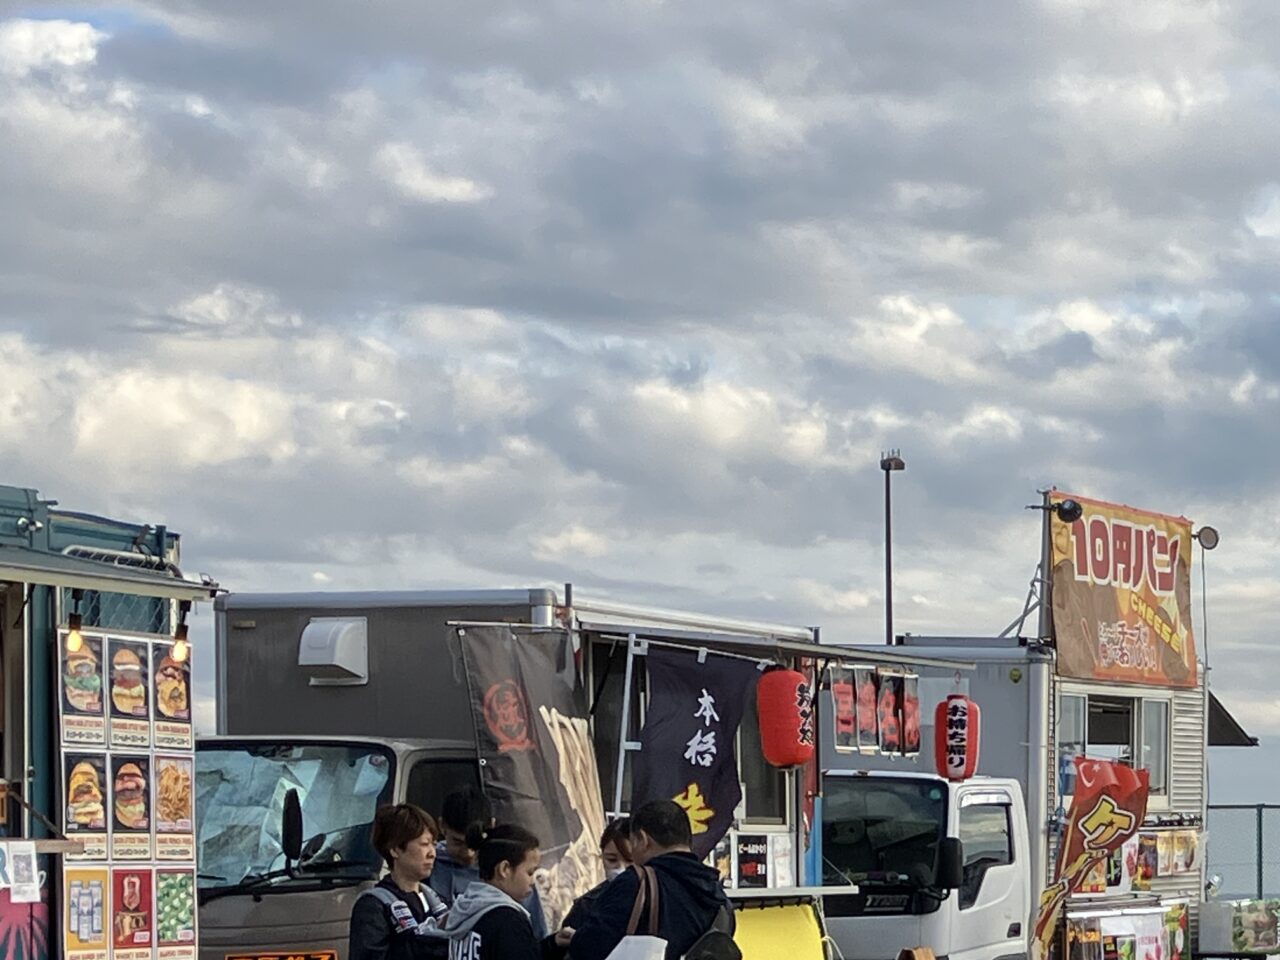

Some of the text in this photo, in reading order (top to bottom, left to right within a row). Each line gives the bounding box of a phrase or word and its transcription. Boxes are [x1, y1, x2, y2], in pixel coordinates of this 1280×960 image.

[1071, 514, 1180, 597] 10円パン
[1130, 591, 1182, 652] CHEESE
[946, 704, 968, 768] お持ち帰り
